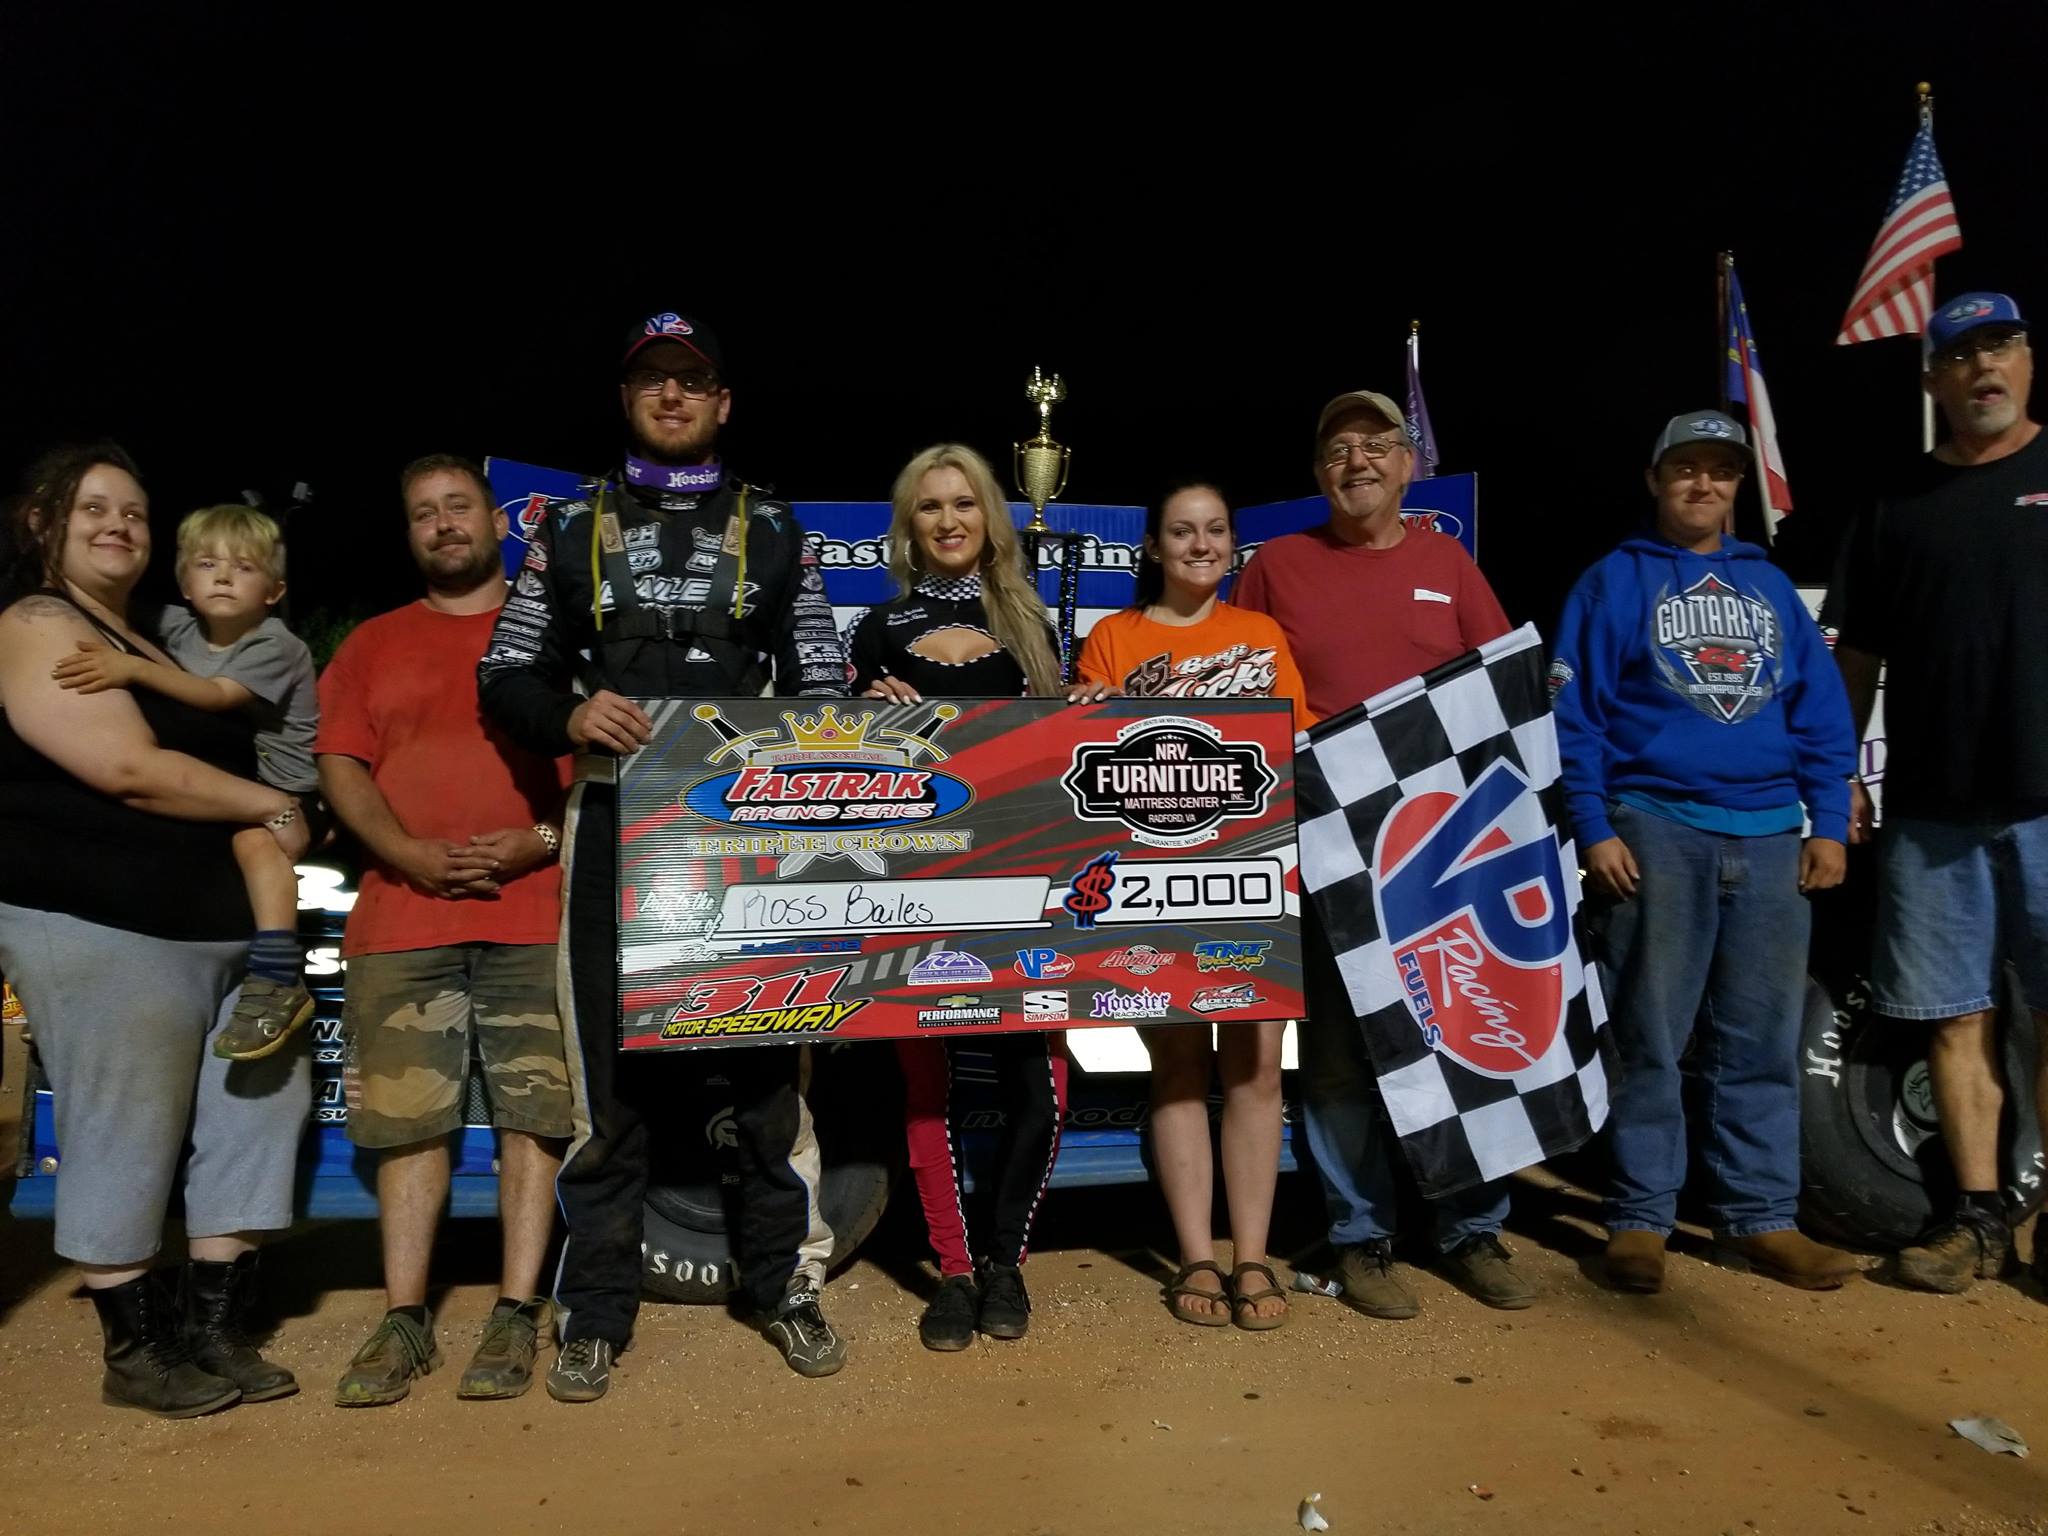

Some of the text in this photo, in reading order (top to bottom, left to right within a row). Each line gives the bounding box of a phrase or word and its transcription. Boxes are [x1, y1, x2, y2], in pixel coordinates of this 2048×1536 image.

[1657, 595, 1724, 645] GOTTA
[1155, 743, 1188, 760] NRV
[727, 767, 932, 800] FASTRAK
[1097, 765, 1243, 793] FURNITURE
[730, 803, 936, 821] RACING SERIES
[1124, 796, 1220, 809] MATTRESS CENTER
[1186, 813, 1197, 822] VA
[690, 831, 972, 855] TRIPLE CROWN
[1380, 764, 1570, 963] VP
[743, 884, 934, 928] Ross Bailes
[1121, 872, 1272, 917] 2,000
[1016, 948, 1057, 978] VP
[1194, 942, 1271, 958] TNT
[672, 965, 852, 1022] 311
[1092, 987, 1170, 1016] Hoosier
[1397, 951, 1442, 1048] FUELS
[1418, 927, 1538, 1062] Racing
[664, 1000, 866, 1036] MOTOR SPEEDWAY
[918, 1007, 1000, 1021] PERFORMANCE
[1025, 1012, 1067, 1021] SIMPSON
